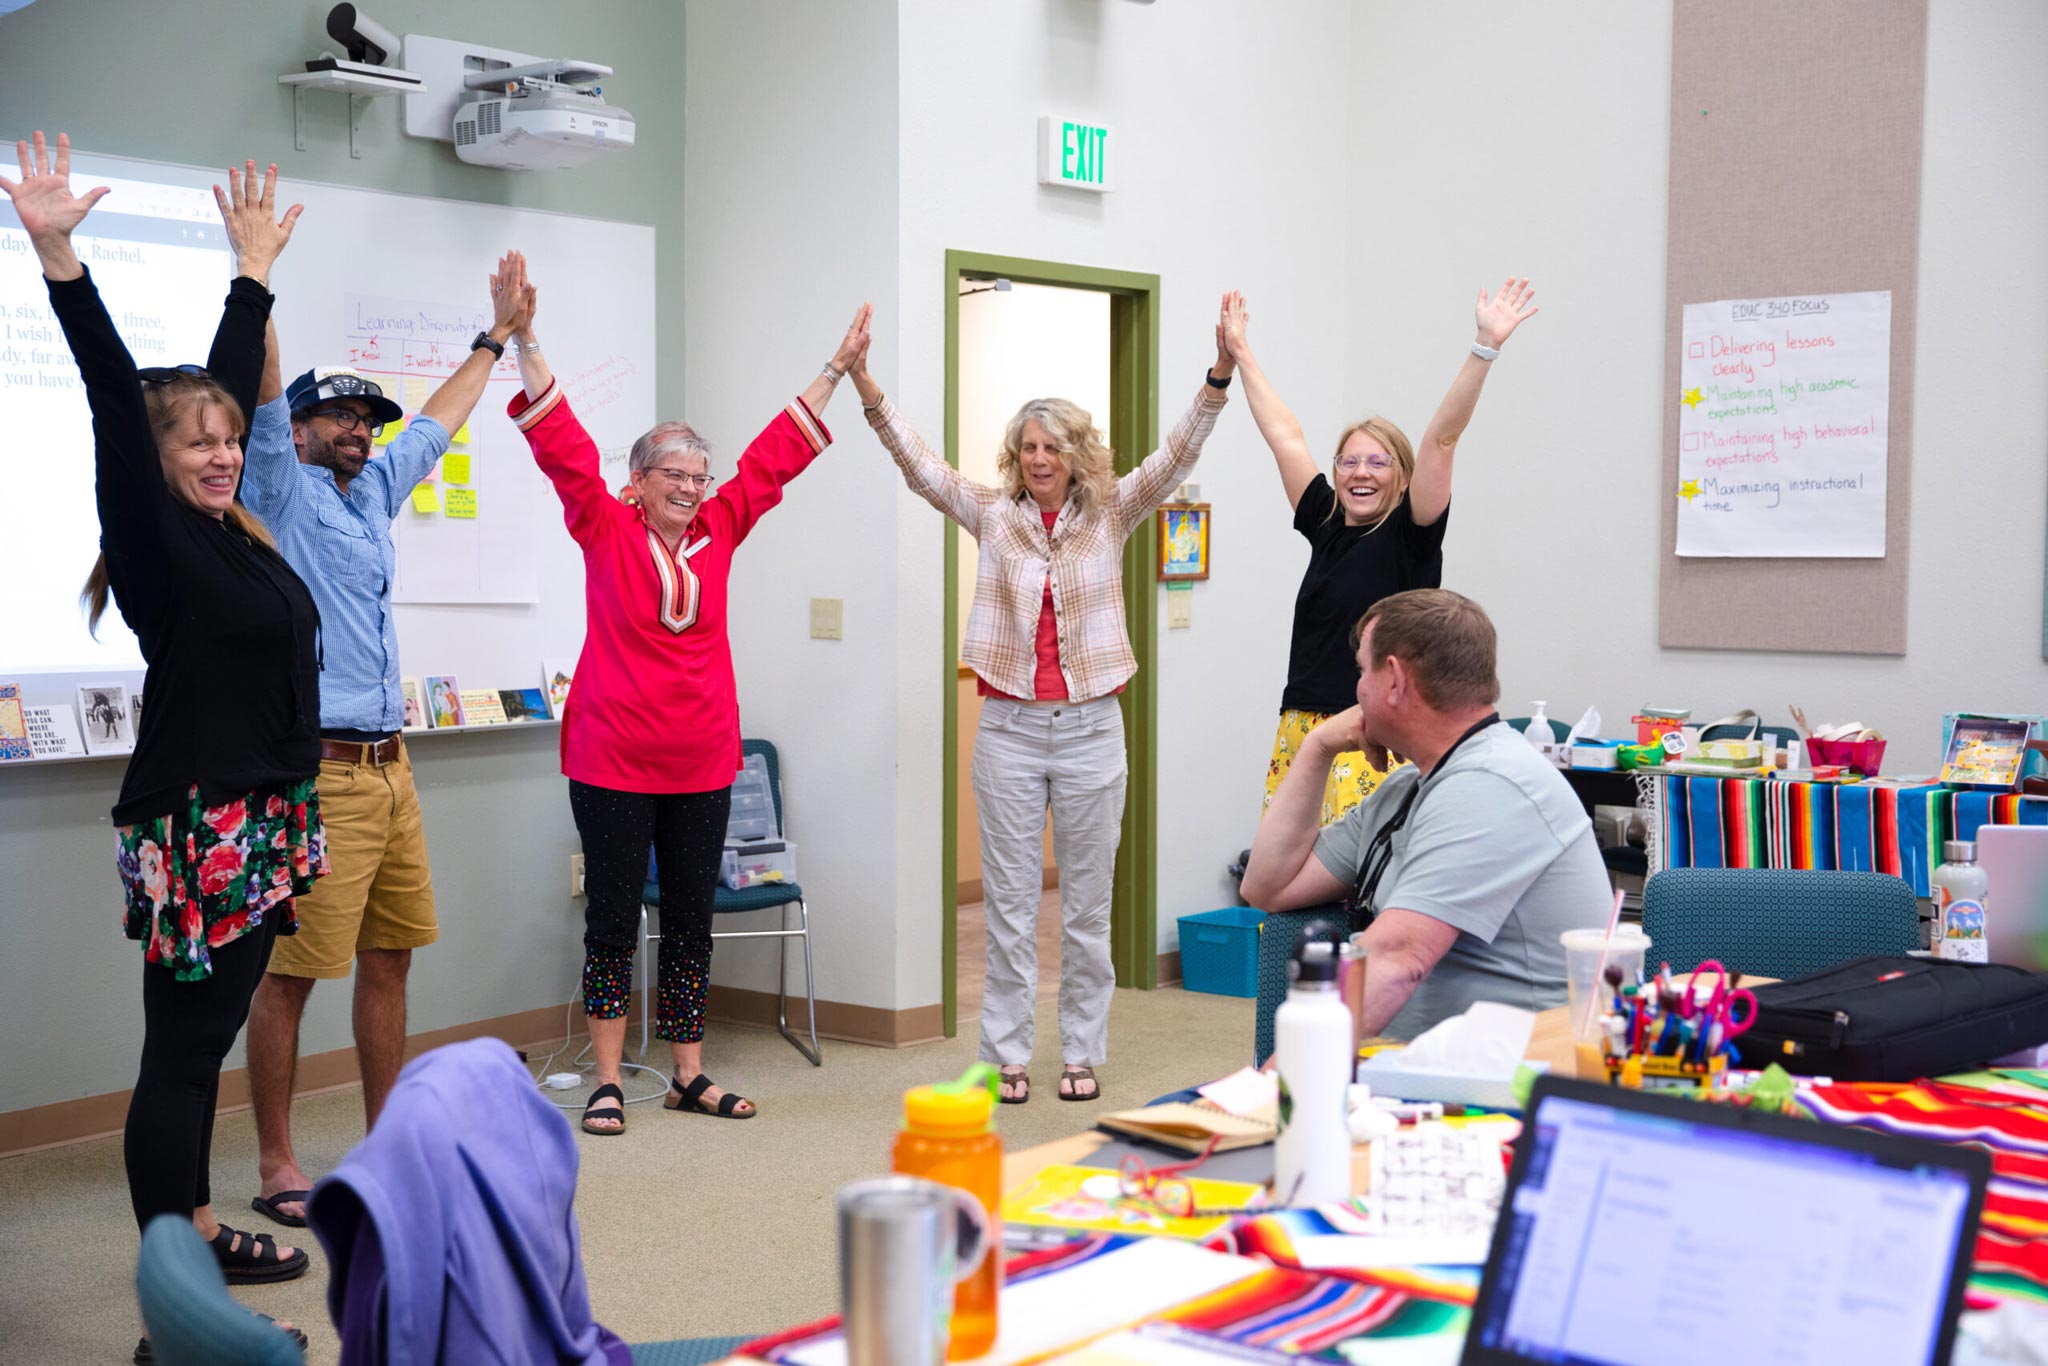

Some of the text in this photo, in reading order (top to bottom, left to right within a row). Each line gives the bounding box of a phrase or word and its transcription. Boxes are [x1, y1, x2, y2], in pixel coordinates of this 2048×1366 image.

[592, 120, 608, 128] EPSON
[1062, 122, 1107, 184] EXIT
[0, 234, 30, 256] day
[92, 244, 146, 265] Rachel,
[16, 304, 43, 322] six,
[124, 311, 166, 331] three,
[358, 302, 414, 336] Learning
[419, 312, 469, 337] Diversity
[1732, 300, 1830, 318] EDUC 340 FOCUS
[17, 326, 53, 343] wish
[0, 347, 26, 366] dy,
[31, 348, 52, 364] far
[1711, 329, 1835, 367] Delivering lessons
[5, 373, 33, 388] you
[38, 371, 75, 387] have
[1713, 360, 1755, 384] clearly
[1706, 377, 1859, 403] Maintaining high academic
[1708, 404, 1778, 422] expectations
[1703, 416, 1875, 451] Maintaining high behavioral
[1705, 451, 1779, 470] expectations
[1703, 473, 1863, 508] Maximizing instructional
[1704, 501, 1735, 512] time
